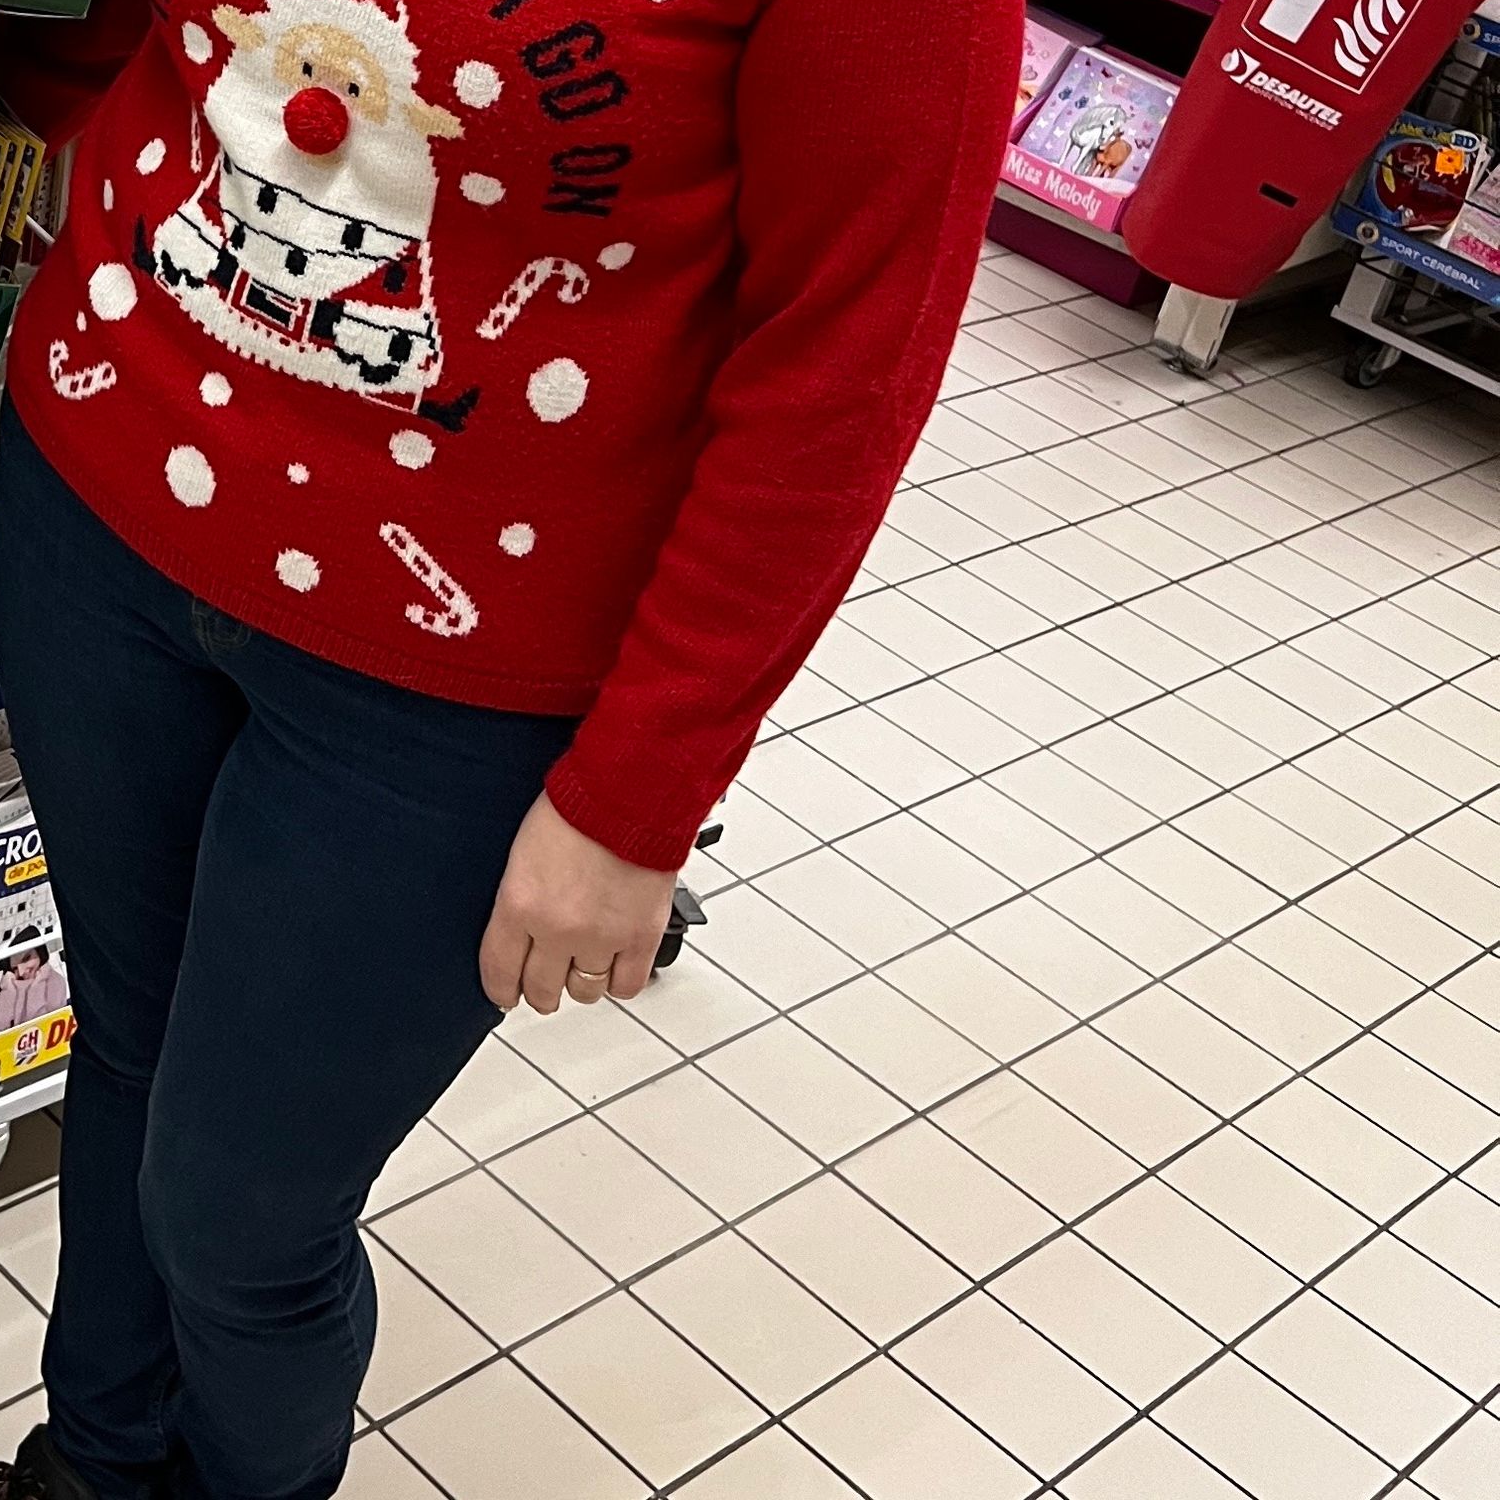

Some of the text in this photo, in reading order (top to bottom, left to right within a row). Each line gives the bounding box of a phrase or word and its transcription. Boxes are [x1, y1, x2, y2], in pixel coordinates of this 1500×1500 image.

[520, 19, 631, 124] GO
[1249, 71, 1343, 126] DESAUTEL
[542, 142, 634, 219] ON
[1004, 150, 1103, 216] Miss Melody
[1381, 237, 1420, 260] SPORT
[17, 1029, 40, 1052] GH
